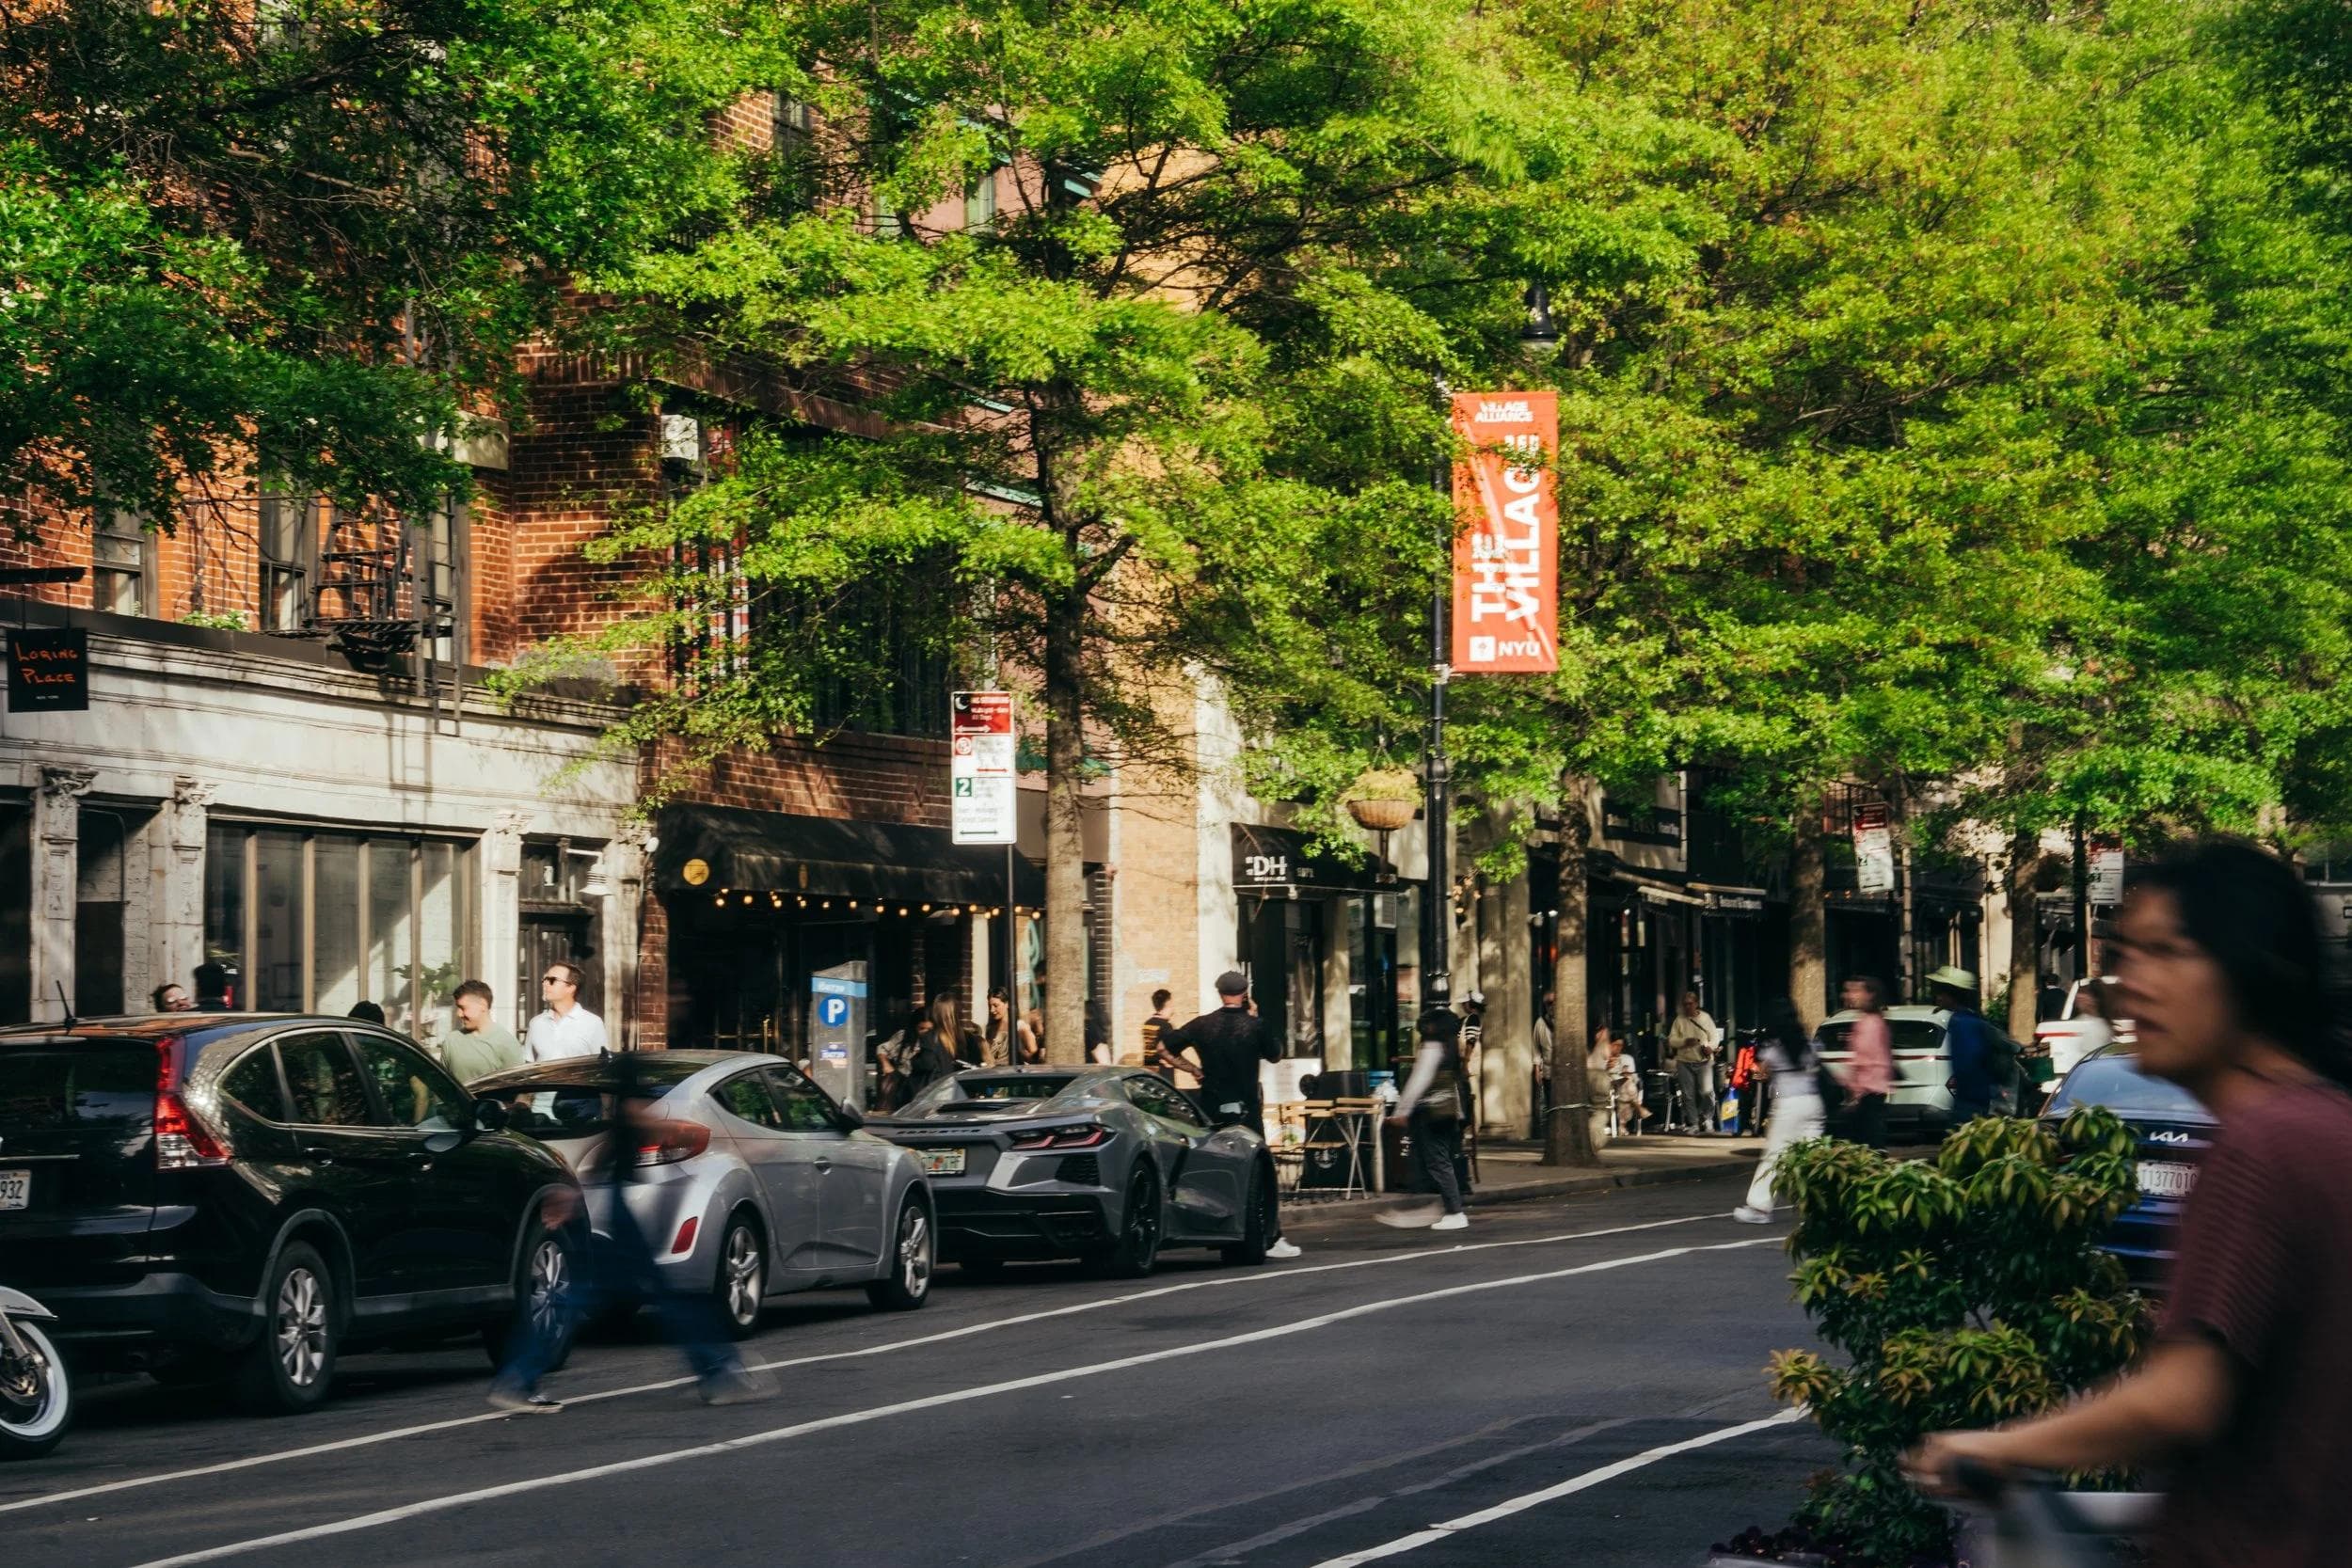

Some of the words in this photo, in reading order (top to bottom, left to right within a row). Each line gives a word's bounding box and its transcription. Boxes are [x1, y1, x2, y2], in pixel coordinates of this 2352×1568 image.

[1474, 411, 1534, 422] ALLIANCE
[1504, 434, 1540, 622] VILLAGE
[1470, 533, 1505, 623] THE
[1498, 641, 1540, 657] NYU
[958, 778, 971, 797] 2
[828, 998, 846, 1023] P
